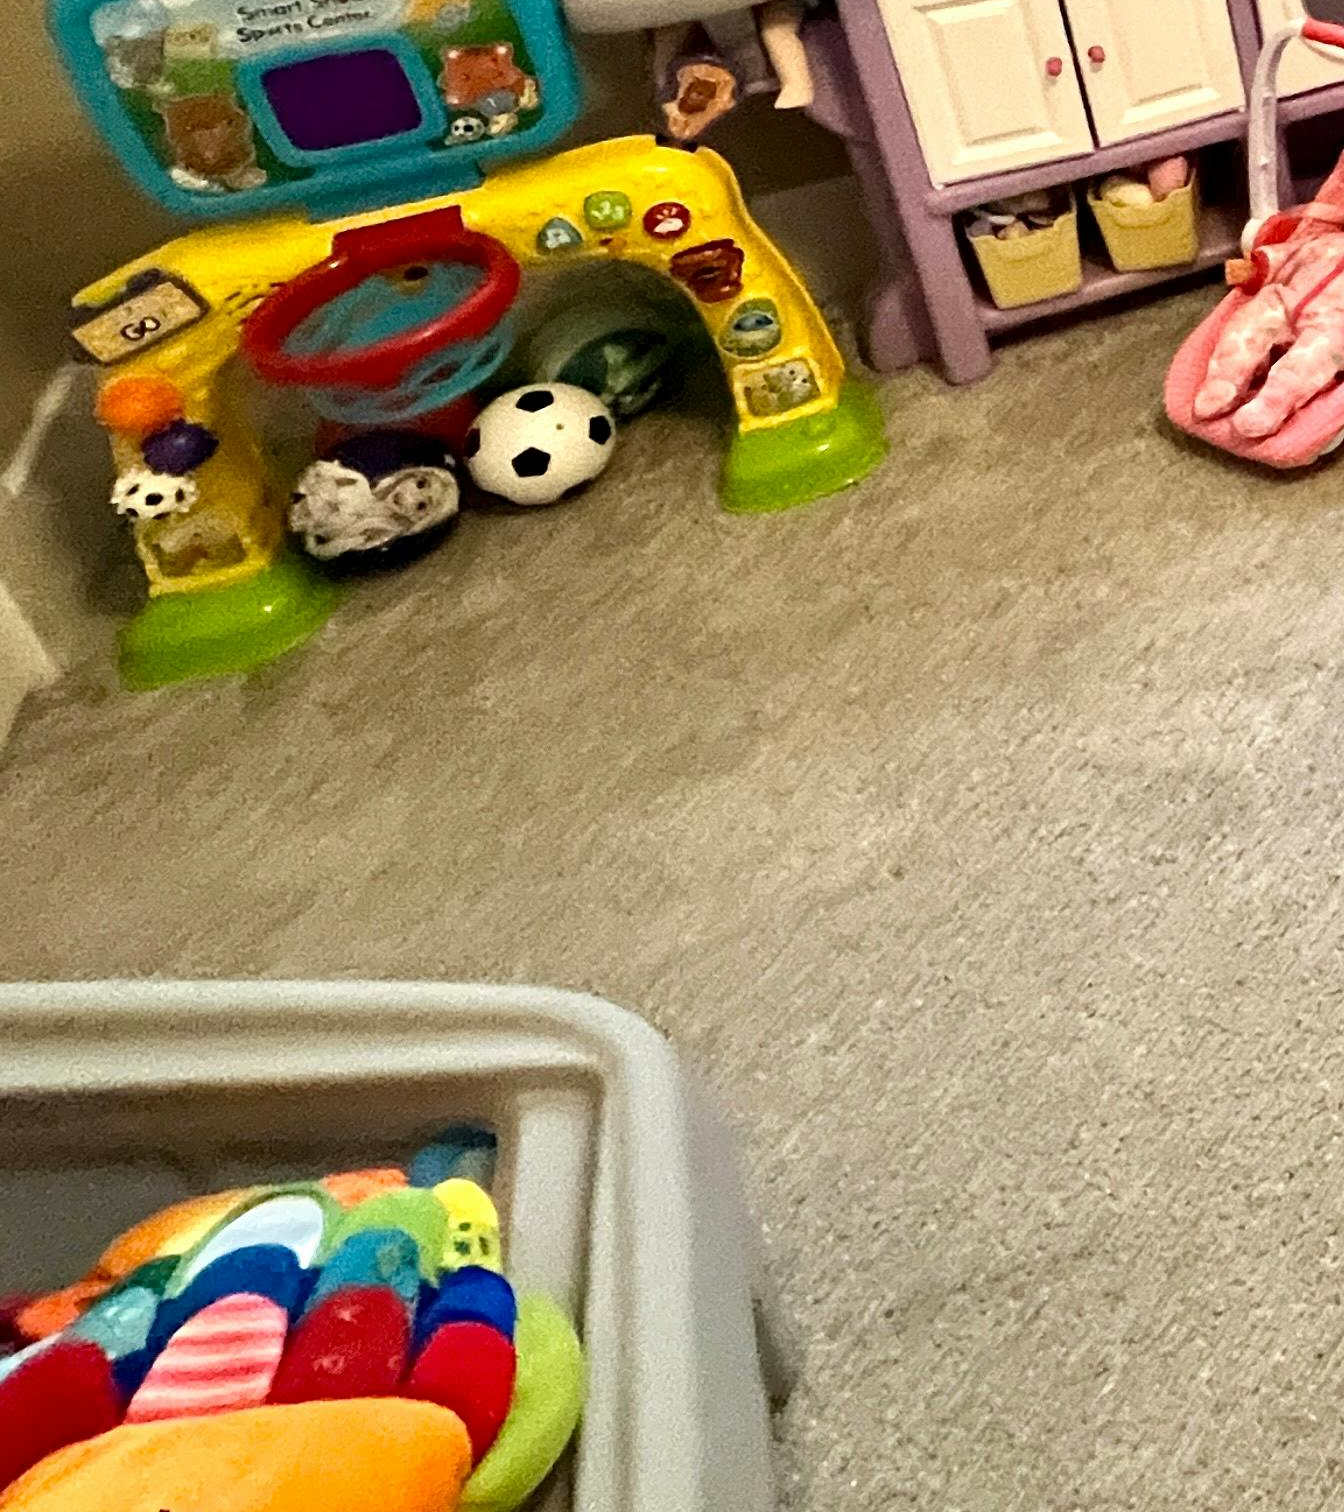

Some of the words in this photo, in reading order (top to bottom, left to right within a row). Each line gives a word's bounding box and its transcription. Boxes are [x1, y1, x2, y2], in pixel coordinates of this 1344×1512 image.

[237, 1, 302, 21] Smart
[236, 22, 303, 43] Sports
[307, 11, 370, 29] Center
[120, 316, 161, 341] GO
